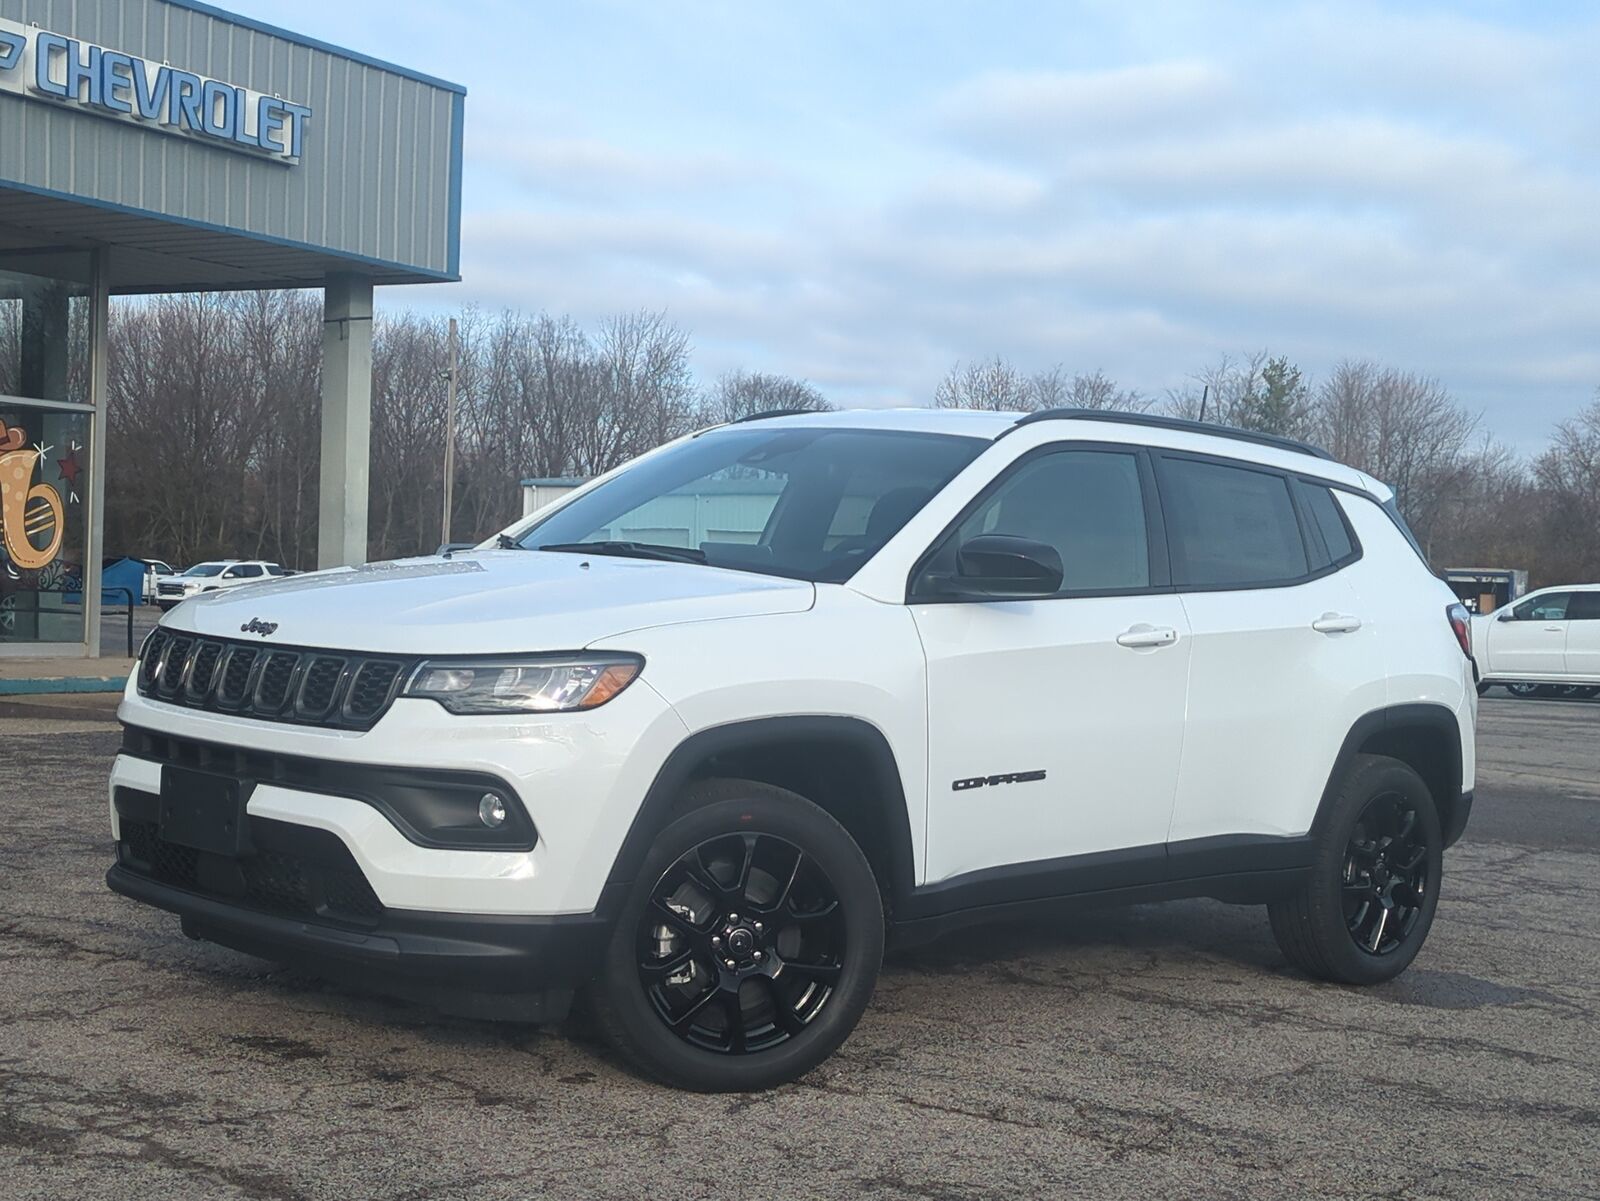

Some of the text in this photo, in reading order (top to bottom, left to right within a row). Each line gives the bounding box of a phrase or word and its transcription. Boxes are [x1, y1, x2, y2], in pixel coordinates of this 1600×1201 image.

[35, 31, 312, 157] CHEVROLET
[241, 617, 279, 637] Jeep
[952, 769, 1046, 791] COMPASS
